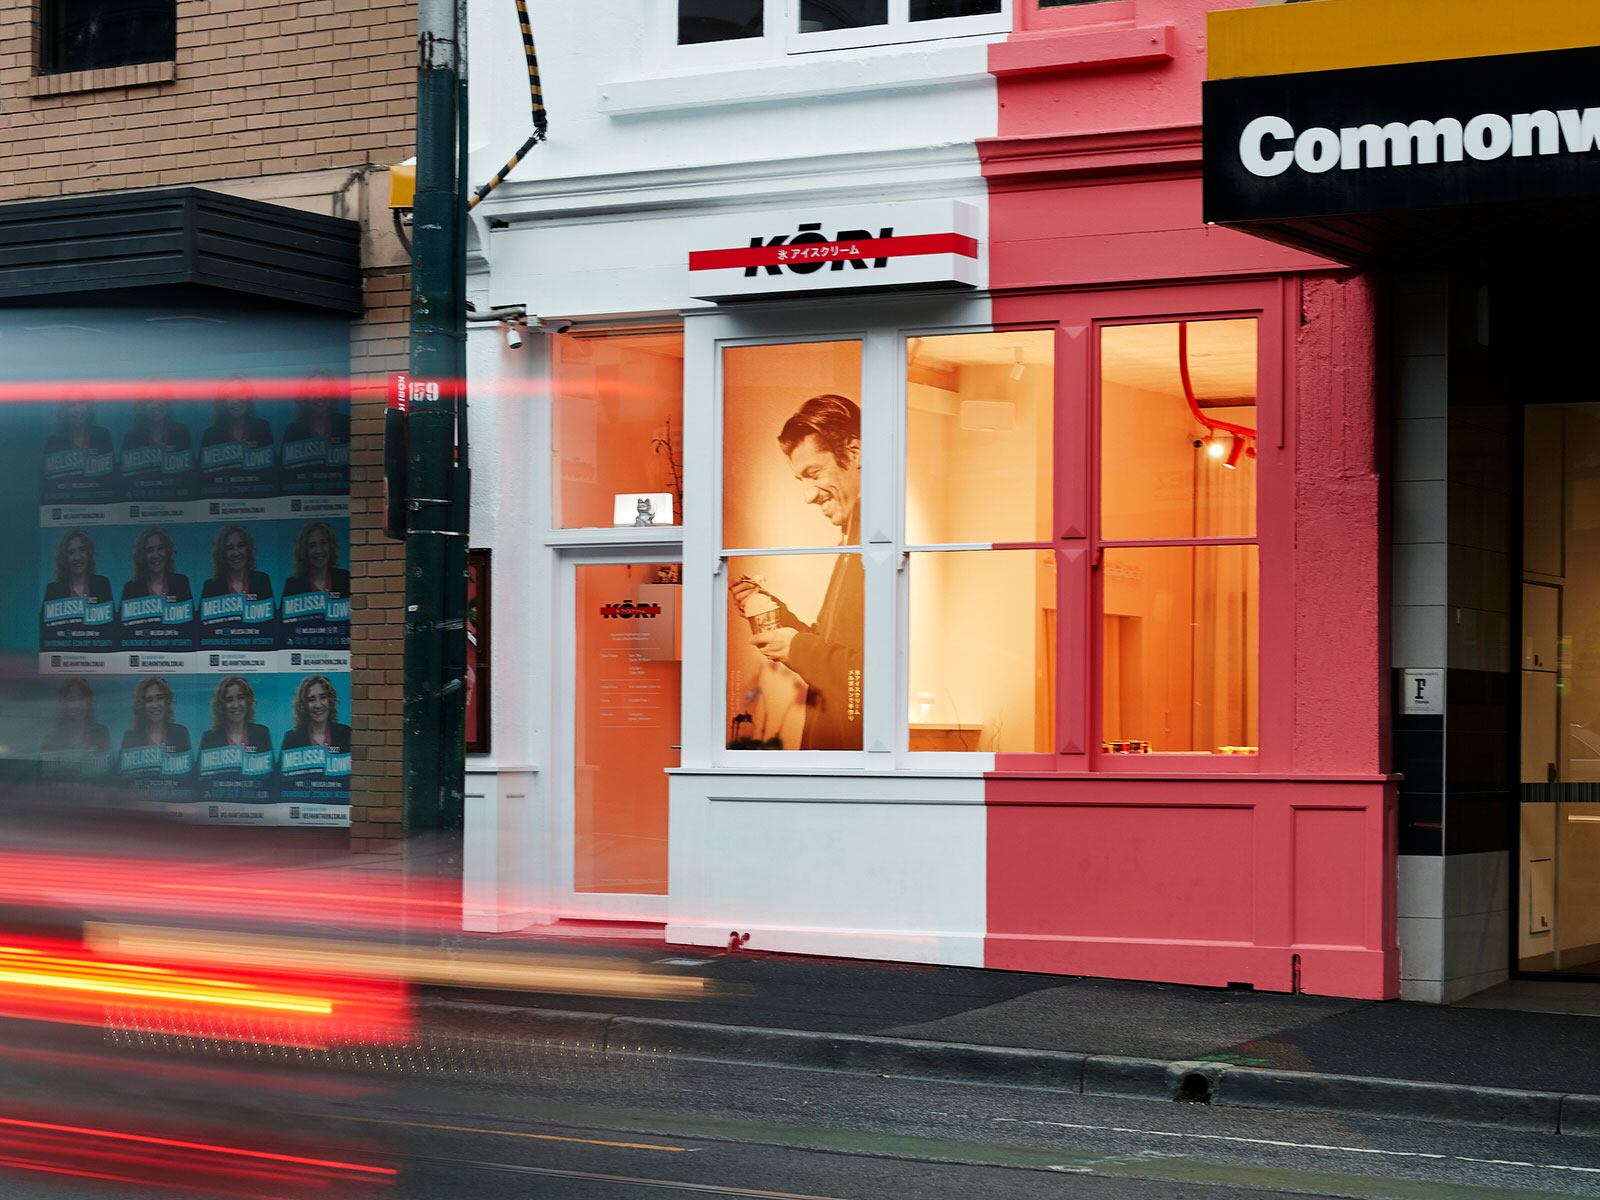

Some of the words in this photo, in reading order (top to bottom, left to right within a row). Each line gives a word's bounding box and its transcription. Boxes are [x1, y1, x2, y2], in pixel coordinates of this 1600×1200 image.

[1239, 107, 1600, 177] Commonw
[46, 600, 84, 618] MELISSA
[86, 605, 111, 622] LOWE
[124, 598, 162, 617] MELISSA
[164, 604, 190, 621] LOWE
[203, 596, 243, 616] MELISSA
[245, 602, 271, 619] LOWE
[285, 595, 326, 615] MELISSA
[328, 601, 350, 618] LOW
[202, 749, 242, 767] MELISSA
[244, 755, 271, 771] LOWE
[284, 749, 325, 768] MELISSA
